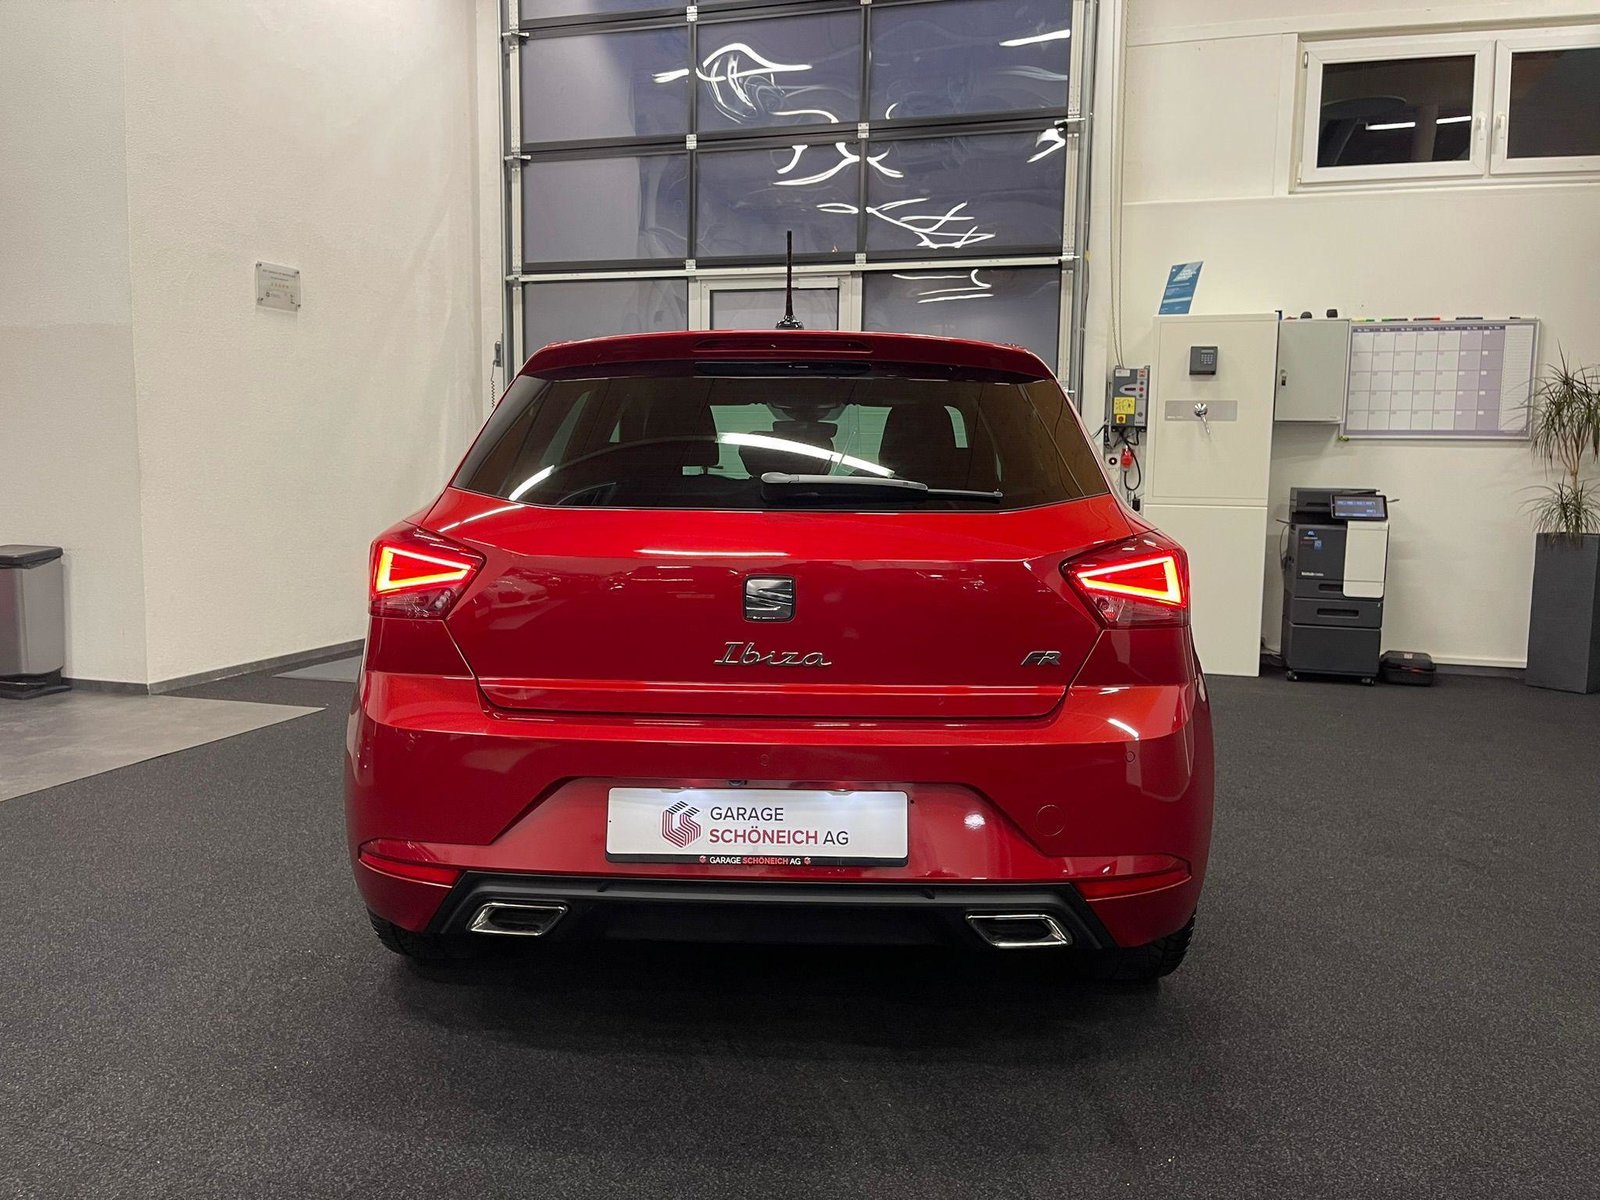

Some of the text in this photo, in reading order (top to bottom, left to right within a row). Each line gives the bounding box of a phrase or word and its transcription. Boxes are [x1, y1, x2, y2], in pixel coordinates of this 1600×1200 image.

[713, 641, 833, 666] Ibiza
[1020, 650, 1062, 666] FR
[710, 806, 784, 822] GARAGE
[709, 825, 849, 846] SCHÖNEICH AG
[709, 855, 801, 866] GARAGE SCHÖNEICH AG
